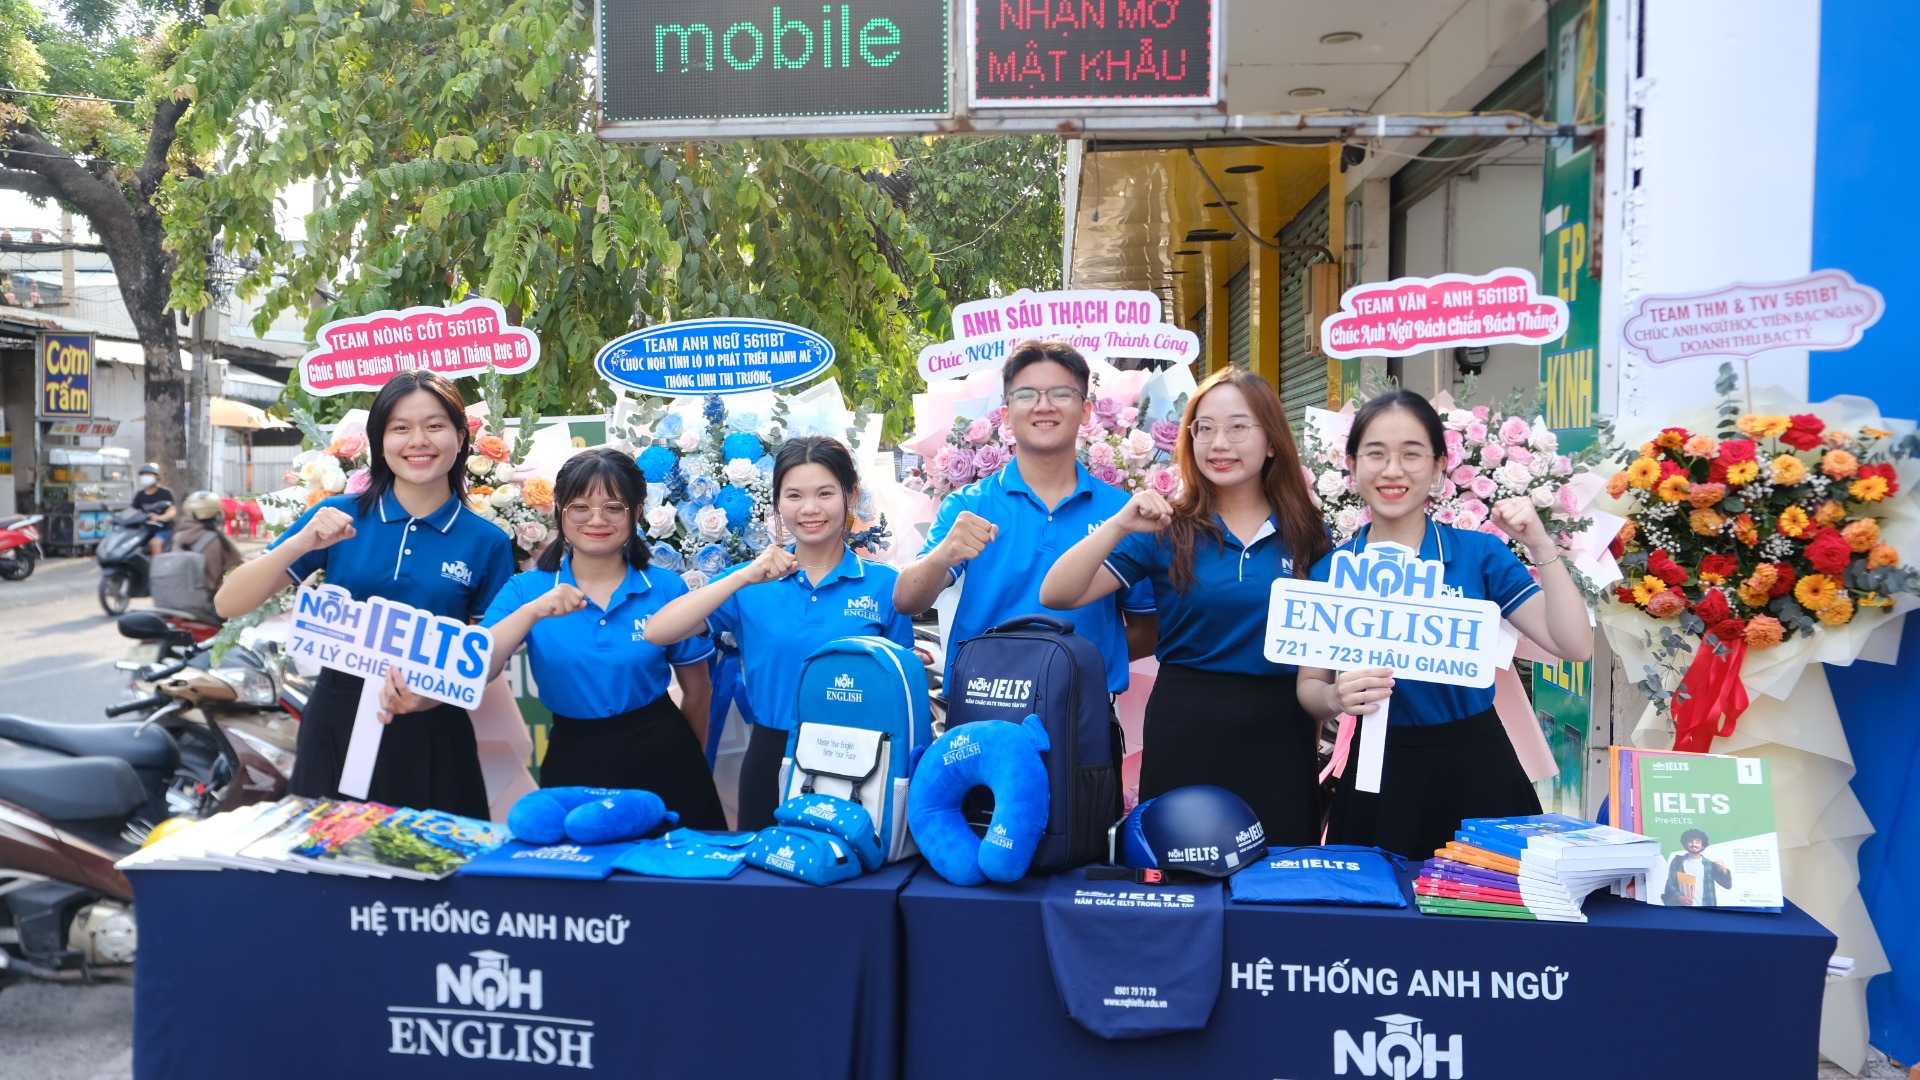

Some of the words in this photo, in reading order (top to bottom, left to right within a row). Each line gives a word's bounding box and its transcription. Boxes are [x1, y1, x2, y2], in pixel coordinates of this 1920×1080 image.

[655, 5, 901, 73] mobile
[1356, 297, 1394, 315] TEAM
[1398, 292, 1427, 312] VĂN
[1443, 289, 1473, 308] ANH
[1477, 285, 1528, 305] 5611BT
[1649, 305, 1690, 323] TEAM
[1694, 300, 1728, 318] THM
[1734, 298, 1745, 313] &
[1749, 293, 1778, 311] TVV
[1785, 286, 1839, 307] 5611BT
[330, 331, 369, 350] TEAM
[373, 323, 413, 346] NÒNG
[416, 318, 443, 341] CỐT
[448, 317, 494, 338] 5611BT
[962, 308, 1002, 338] ANH
[1007, 299, 1043, 330] SÁU
[1048, 300, 1109, 329] THẠCH
[1114, 300, 1151, 325] CAO
[1331, 324, 1360, 345] Chúc
[1361, 322, 1386, 345] Anh
[1386, 318, 1414, 344] Ngữ
[1414, 317, 1447, 338] Bách
[1447, 309, 1481, 336] Chiến
[1483, 312, 1516, 334] Bách
[1517, 308, 1558, 333] Thắng
[1634, 326, 1669, 342] CHÚC
[1672, 323, 1699, 338] ANH
[46, 338, 89, 376] Cơm
[643, 337, 678, 353] TEAM
[682, 336, 709, 351] ANH
[713, 332, 740, 350] NGỮ
[744, 333, 786, 348] 5611BT
[928, 351, 964, 373] Chúc
[965, 340, 1005, 364] NQH
[1104, 331, 1151, 349] Thành
[1153, 331, 1190, 356] Công
[1681, 338, 1730, 353] DOANH
[309, 361, 334, 382] Chúc
[335, 359, 356, 379] NQH
[356, 355, 394, 376] English
[431, 350, 442, 367] 10
[444, 347, 460, 368] Đại
[462, 341, 493, 362] Thắng
[620, 356, 645, 372] CHÚC
[646, 356, 667, 371] NQH
[705, 354, 715, 367] 10
[717, 351, 741, 367] PHÁT
[771, 350, 797, 364] MẠNH
[46, 377, 88, 411] Tấm
[441, 561, 473, 582] NQH
[1334, 549, 1437, 599] NQH
[843, 609, 882, 623] ENGLISH
[1280, 598, 1483, 651] ENGLISH
[299, 591, 361, 629] NQH
[363, 602, 489, 680] IELTS
[292, 635, 314, 656] 74
[318, 644, 341, 662] LÝ
[406, 669, 475, 704] HOÀNG
[1275, 639, 1307, 657] 721
[1329, 645, 1363, 664] 723
[1415, 656, 1479, 678] GIANG
[834, 673, 854, 689] NQH
[967, 677, 992, 691] NQH
[990, 678, 1032, 700] IELTS
[826, 690, 863, 703] ENGLISH
[942, 744, 981, 766] ENGLISH
[949, 734, 970, 749] NQH
[1665, 762, 1690, 771] IELTS
[1744, 764, 1753, 777] 1
[803, 806, 838, 822] ENGLISH
[1653, 791, 1731, 815] IELTS
[1655, 816, 1693, 825] Pre-IELTS
[765, 854, 796, 873] ENGLISH
[1184, 846, 1220, 862] IELTS
[1302, 858, 1361, 871] IELTS
[350, 901, 388, 936] HỆ
[392, 900, 490, 935] THỐNG
[496, 911, 558, 940] ANH
[564, 913, 631, 945] NGỮ
[436, 955, 543, 1011] NQH
[1230, 957, 1274, 997] HỆ
[1280, 957, 1399, 996] THỐNG
[1407, 969, 1481, 998] ANH
[1490, 965, 1569, 1001] NGỮ
[388, 1016, 595, 1069] ENGLISH
[1333, 1018, 1464, 1080] NQH
